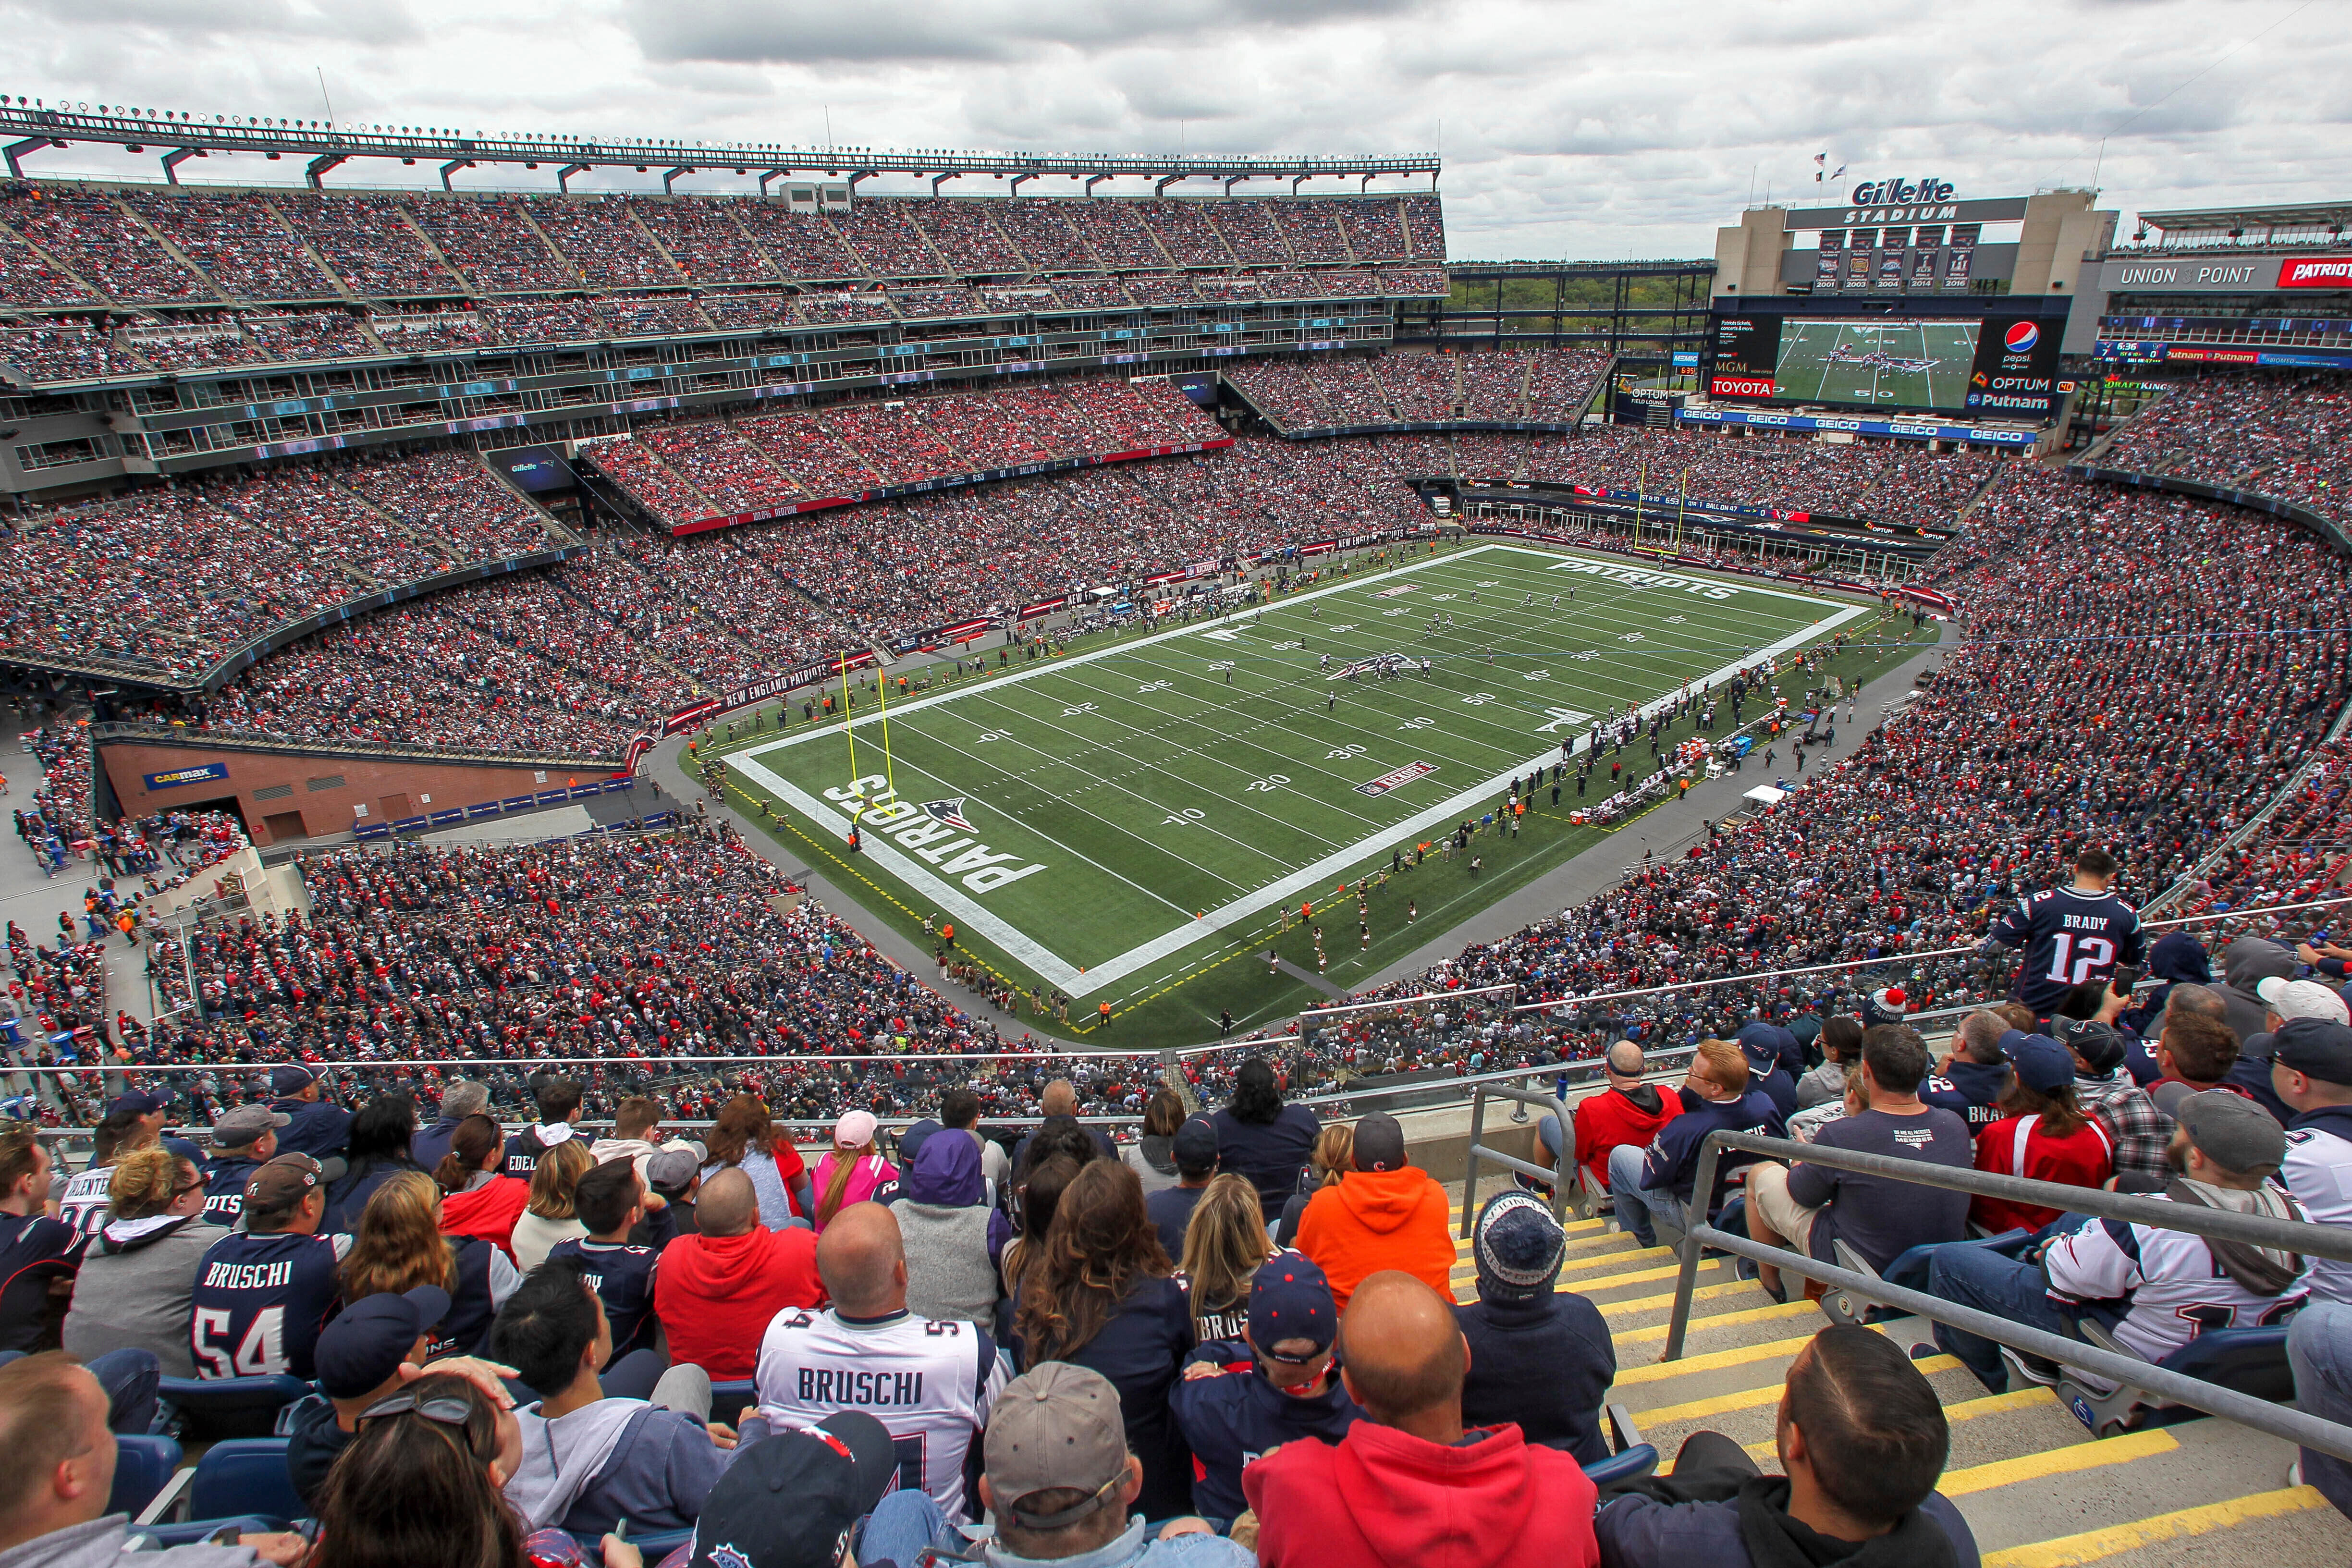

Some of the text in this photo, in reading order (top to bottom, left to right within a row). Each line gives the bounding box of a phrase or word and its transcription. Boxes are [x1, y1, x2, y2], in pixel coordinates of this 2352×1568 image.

[1852, 177, 1954, 207] Gillette
[1843, 206, 1958, 223] STADIUM
[2121, 267, 2255, 284] UNION POINT
[2003, 355, 2030, 363] pepsi
[2214, 353, 2253, 361] Putnam
[1715, 361, 1746, 372] MGM
[1714, 381, 1770, 395] TOYOTA
[1993, 378, 2049, 391] OPTUM
[1632, 389, 1668, 400] OPTUM
[1982, 394, 2048, 409] Putnam
[1683, 410, 1721, 420] GEICO
[1747, 414, 1788, 425] GEICO
[1815, 419, 1859, 430] GEICO
[1889, 424, 1937, 436] GEICO
[1970, 429, 2022, 442] GEICO
[512, 464, 537, 472] Gillette
[728, 505, 797, 526] 1/1 100.0% REDZONE
[1338, 539, 1351, 548] NEW
[1829, 533, 1910, 547] OPTUM
[1196, 563, 1216, 574] KICKOFF
[1546, 561, 1739, 600] PATRIOTS
[1067, 592, 1083, 605] NEW
[1662, 615, 1687, 624] 10
[1617, 632, 1645, 642] 20
[1570, 650, 1600, 661] 30
[1523, 671, 1551, 681] 40
[726, 664, 827, 707] NEW ENGLAND PATRIOTS
[1461, 692, 1495, 705] 50
[1404, 717, 1435, 729] 40
[1329, 744, 1367, 760] 30
[1378, 765, 1425, 786] KICKOFF
[1250, 774, 1291, 792] 20
[1167, 808, 1205, 826] 10
[822, 774, 1048, 894] PATRIOTS
[2063, 914, 2109, 930] BRADY
[2046, 932, 2116, 984] 12
[509, 1155, 537, 1171] EDEL
[1374, 1162, 1384, 1172] C
[204, 1260, 292, 1288] BRUSCHI
[193, 1304, 291, 1380] 54
[798, 1367, 922, 1405] BRUSCHI
